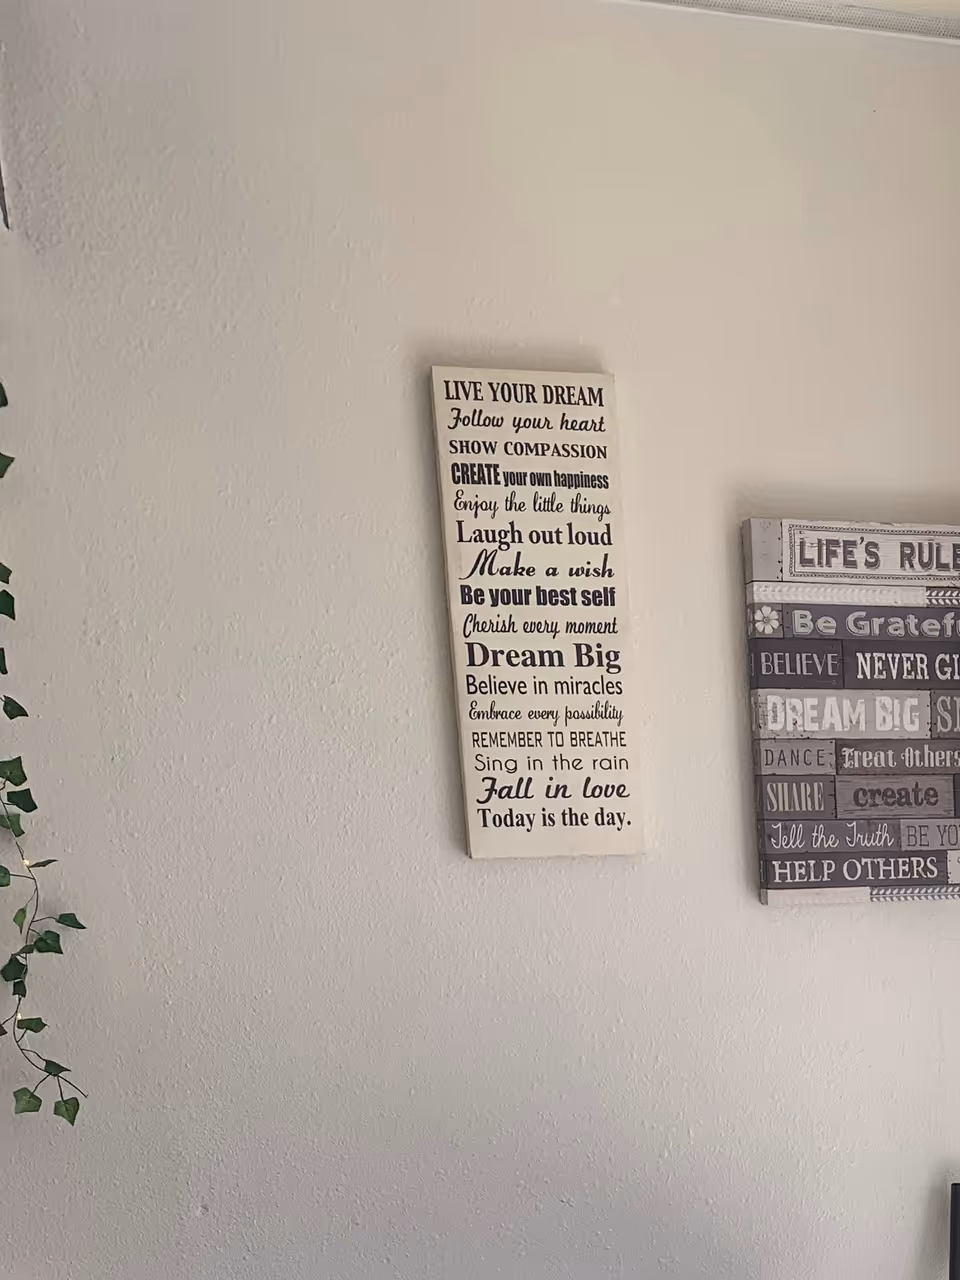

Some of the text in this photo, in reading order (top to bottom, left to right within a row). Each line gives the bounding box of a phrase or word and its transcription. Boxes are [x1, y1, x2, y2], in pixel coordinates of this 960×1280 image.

[444, 380, 604, 407] LIVE YOUR DREAM
[448, 408, 606, 433] Follow your heart
[449, 440, 607, 459] SHOW COMPASSION
[451, 462, 609, 489] CREATE your own happiness
[454, 490, 611, 521] Enjoy the little things
[456, 520, 613, 551] Laugh out loud
[459, 549, 615, 580] Make a wish
[799, 536, 880, 569] LIFE'S
[460, 585, 615, 607] Be your best self
[463, 614, 618, 639] Cherish every moment
[792, 610, 837, 636] Be
[465, 642, 622, 674] Dream Big
[760, 652, 839, 675] BELIEVE
[856, 652, 930, 680] NEVER
[466, 675, 623, 695] Believe in miracles
[469, 701, 623, 726] Embrace every possibility
[766, 694, 920, 732] DREAM BIG
[472, 731, 627, 747] REMEMBER TO BREATHE
[474, 754, 629, 774] Sing in the rain
[764, 748, 826, 766] DANCE
[841, 747, 897, 768] Treat
[476, 776, 630, 804] Fall in love
[766, 782, 825, 812] SHARE
[852, 781, 939, 807] create
[477, 806, 632, 832] Today is the day.
[771, 820, 894, 849] Tell the Truth
[906, 826, 930, 847] BE
[772, 857, 938, 883] HELP OTHERS
